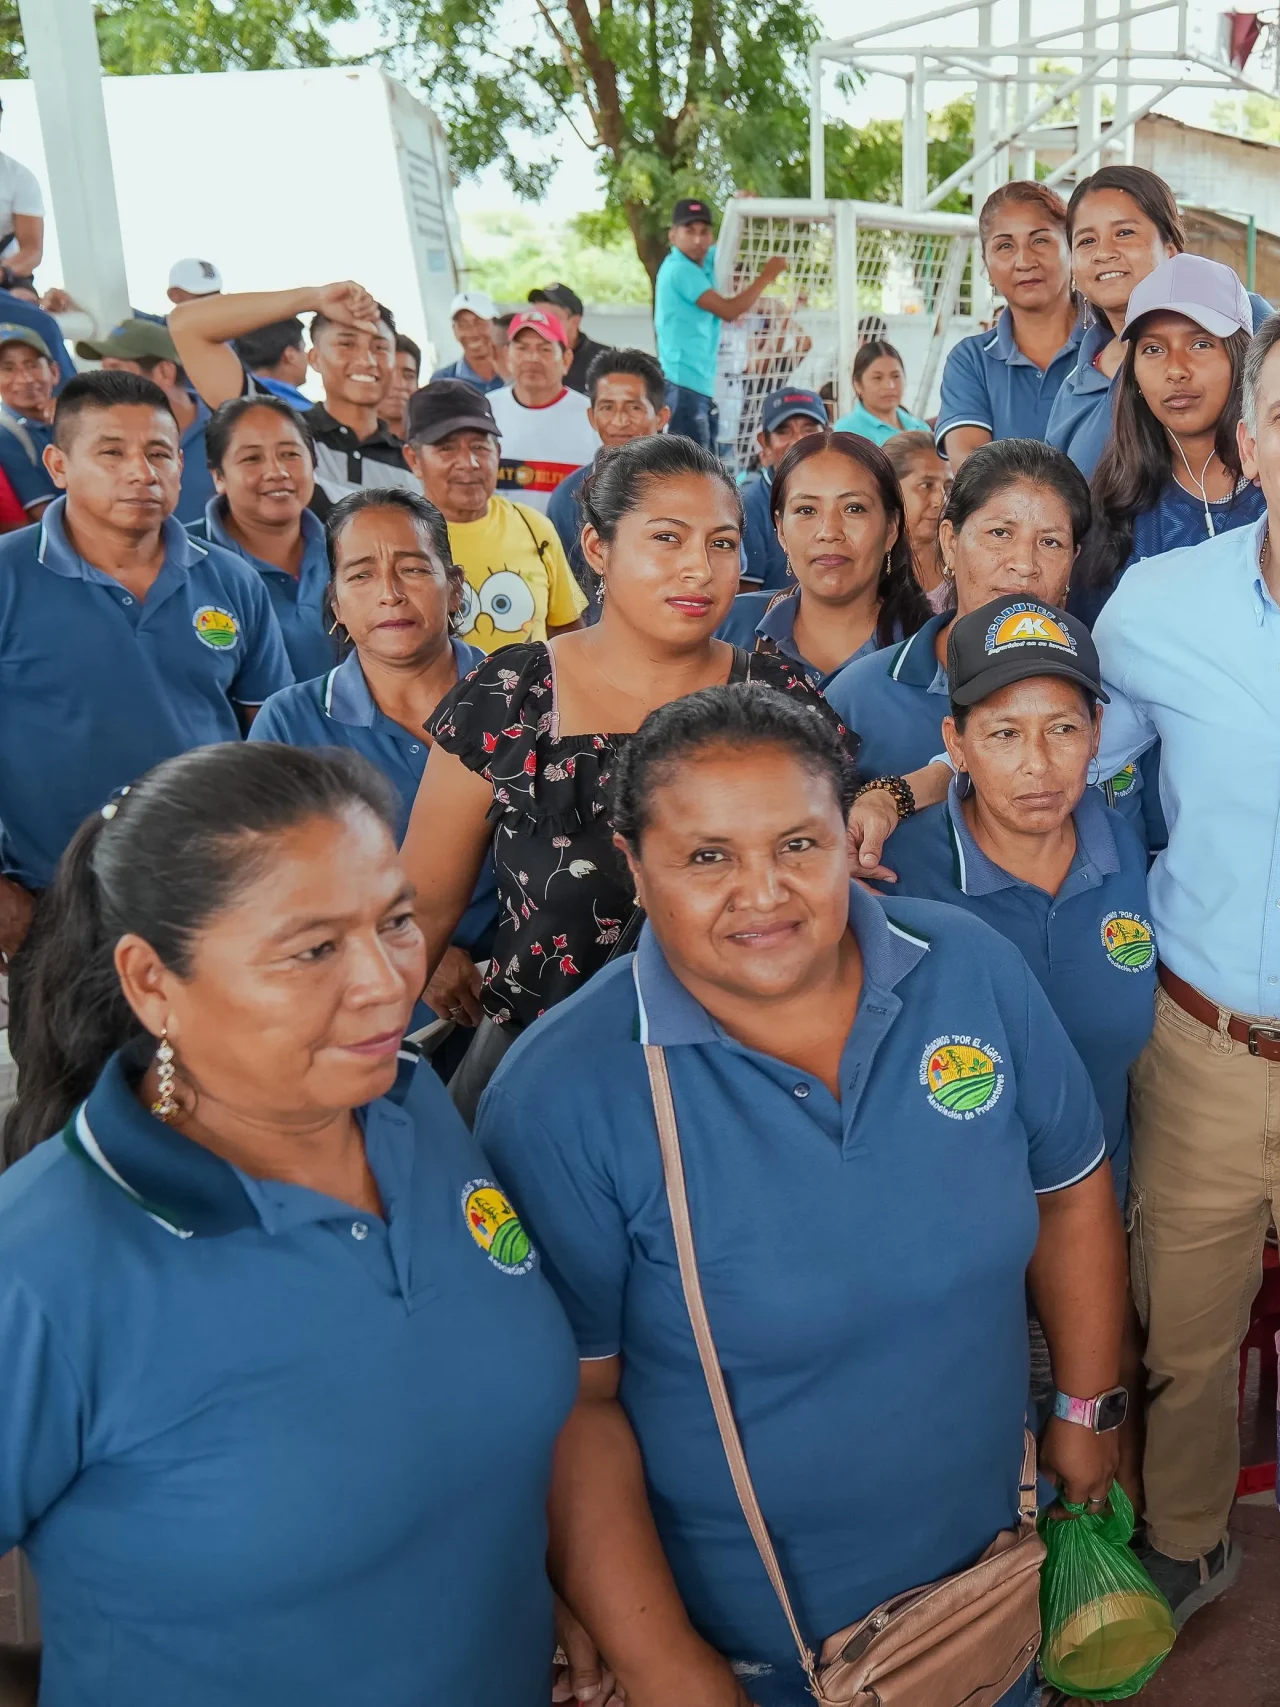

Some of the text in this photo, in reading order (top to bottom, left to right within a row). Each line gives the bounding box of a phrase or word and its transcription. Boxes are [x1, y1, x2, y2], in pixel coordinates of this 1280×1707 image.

[1012, 617, 1051, 636] AK
[1133, 913, 1141, 922] EL
[971, 1037, 983, 1048] EL
[926, 1073, 1005, 1120] Asociación de Productores
